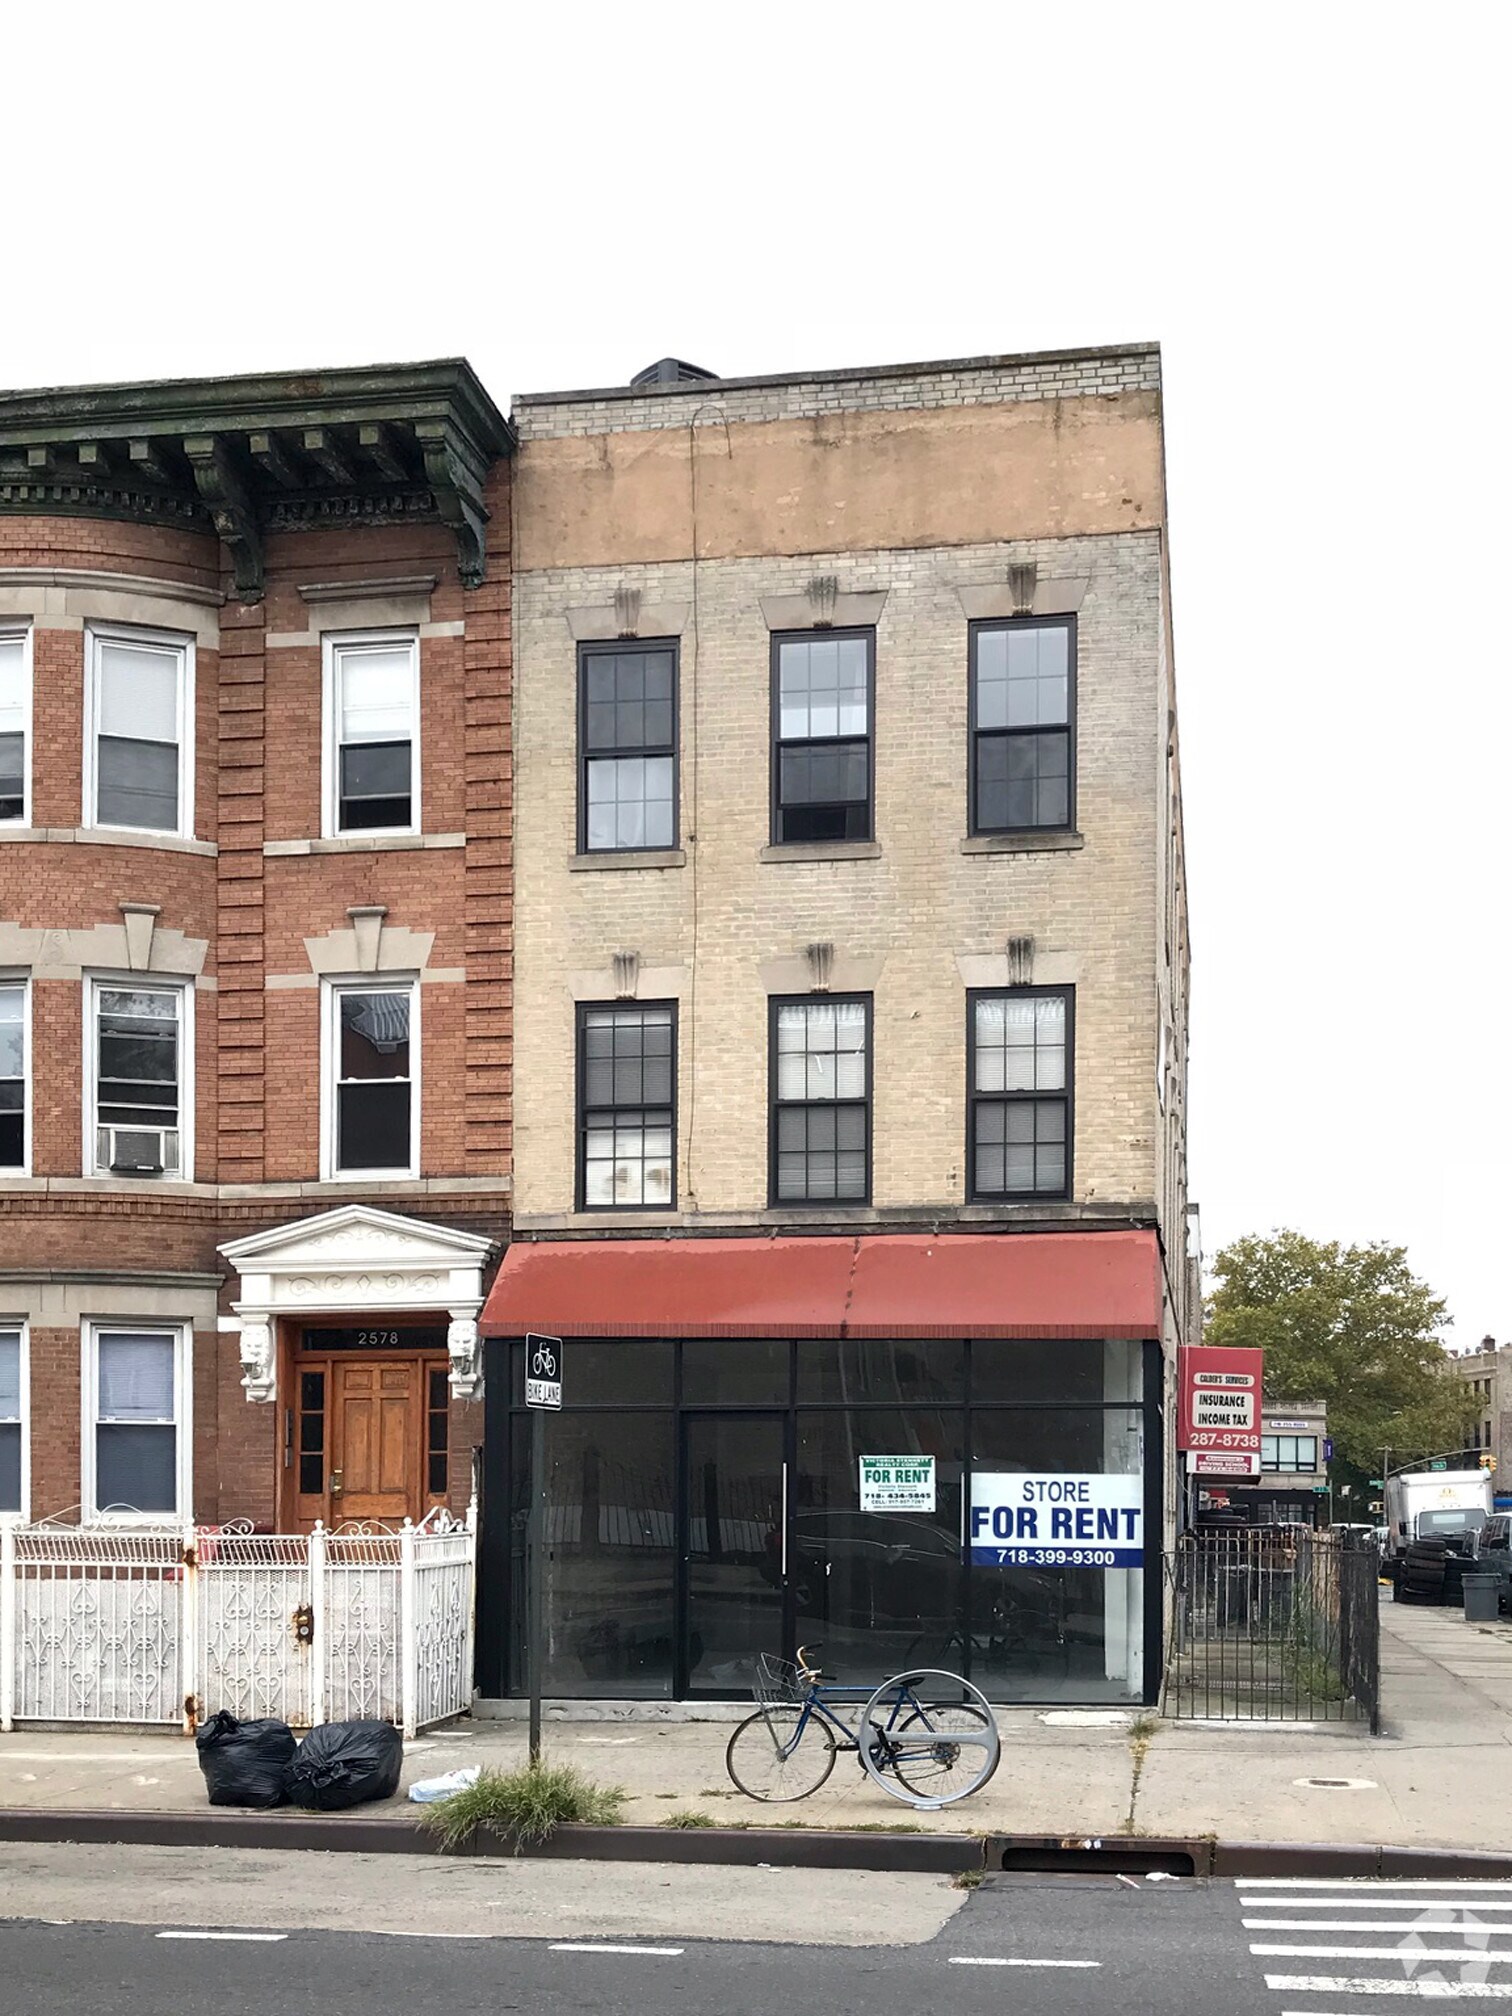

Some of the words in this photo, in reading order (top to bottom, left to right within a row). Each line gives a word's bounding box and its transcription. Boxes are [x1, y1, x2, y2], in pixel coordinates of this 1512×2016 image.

[358, 1331, 398, 1345] 2578
[528, 1383, 542, 1400] BIKE
[543, 1385, 559, 1402] LANE
[1199, 1394, 1245, 1407] INSURANCE
[1198, 1413, 1230, 1425] INCOME
[1232, 1414, 1248, 1426] TAX
[1190, 1432, 1259, 1448] 287-8738
[865, 1469, 891, 1483] FOR
[895, 1469, 930, 1483] RENT
[1022, 1481, 1090, 1502] STORE
[972, 1506, 1038, 1539] FOR
[1052, 1507, 1141, 1540] RENT
[997, 1549, 1115, 1565] 718-399-9300
